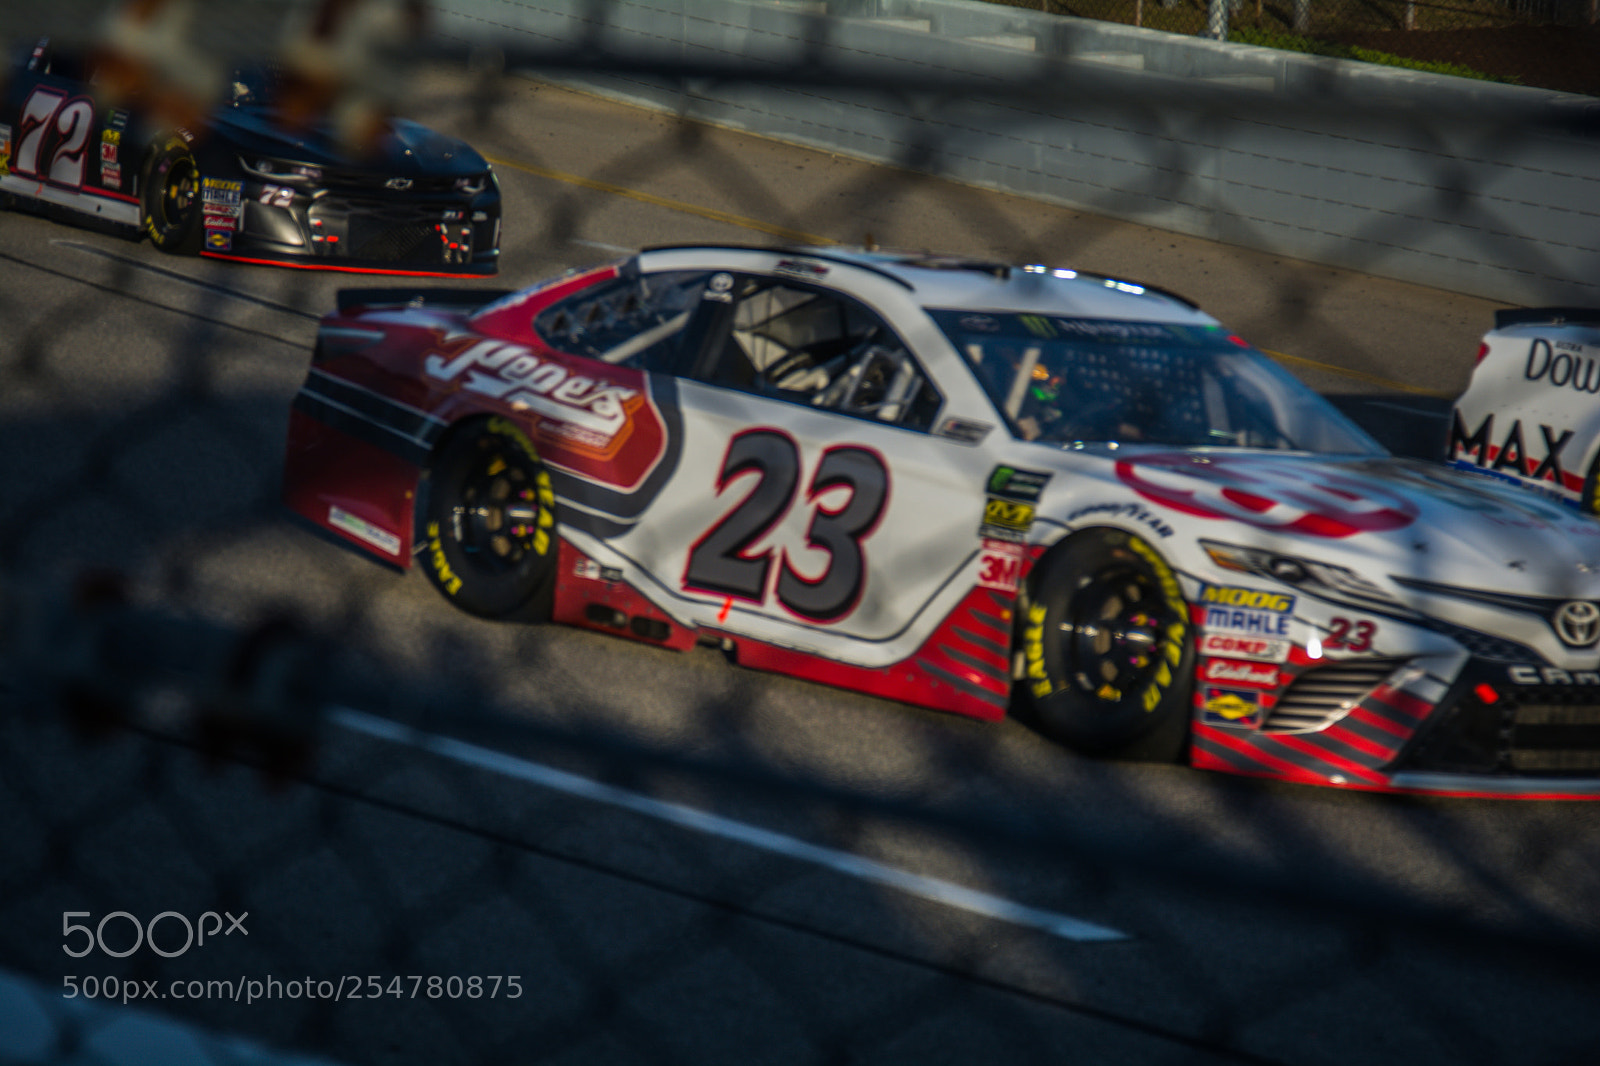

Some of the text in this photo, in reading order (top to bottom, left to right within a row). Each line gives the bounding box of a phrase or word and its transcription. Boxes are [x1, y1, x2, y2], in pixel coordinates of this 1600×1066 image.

[15, 84, 96, 194] 72
[261, 186, 295, 208] 72
[1448, 406, 1576, 487] MAX
[681, 426, 892, 626] 23
[979, 555, 1018, 582] 3M
[1203, 586, 1291, 612] MOOG
[1206, 607, 1289, 635] MAHLE
[1322, 616, 1379, 653] 23
